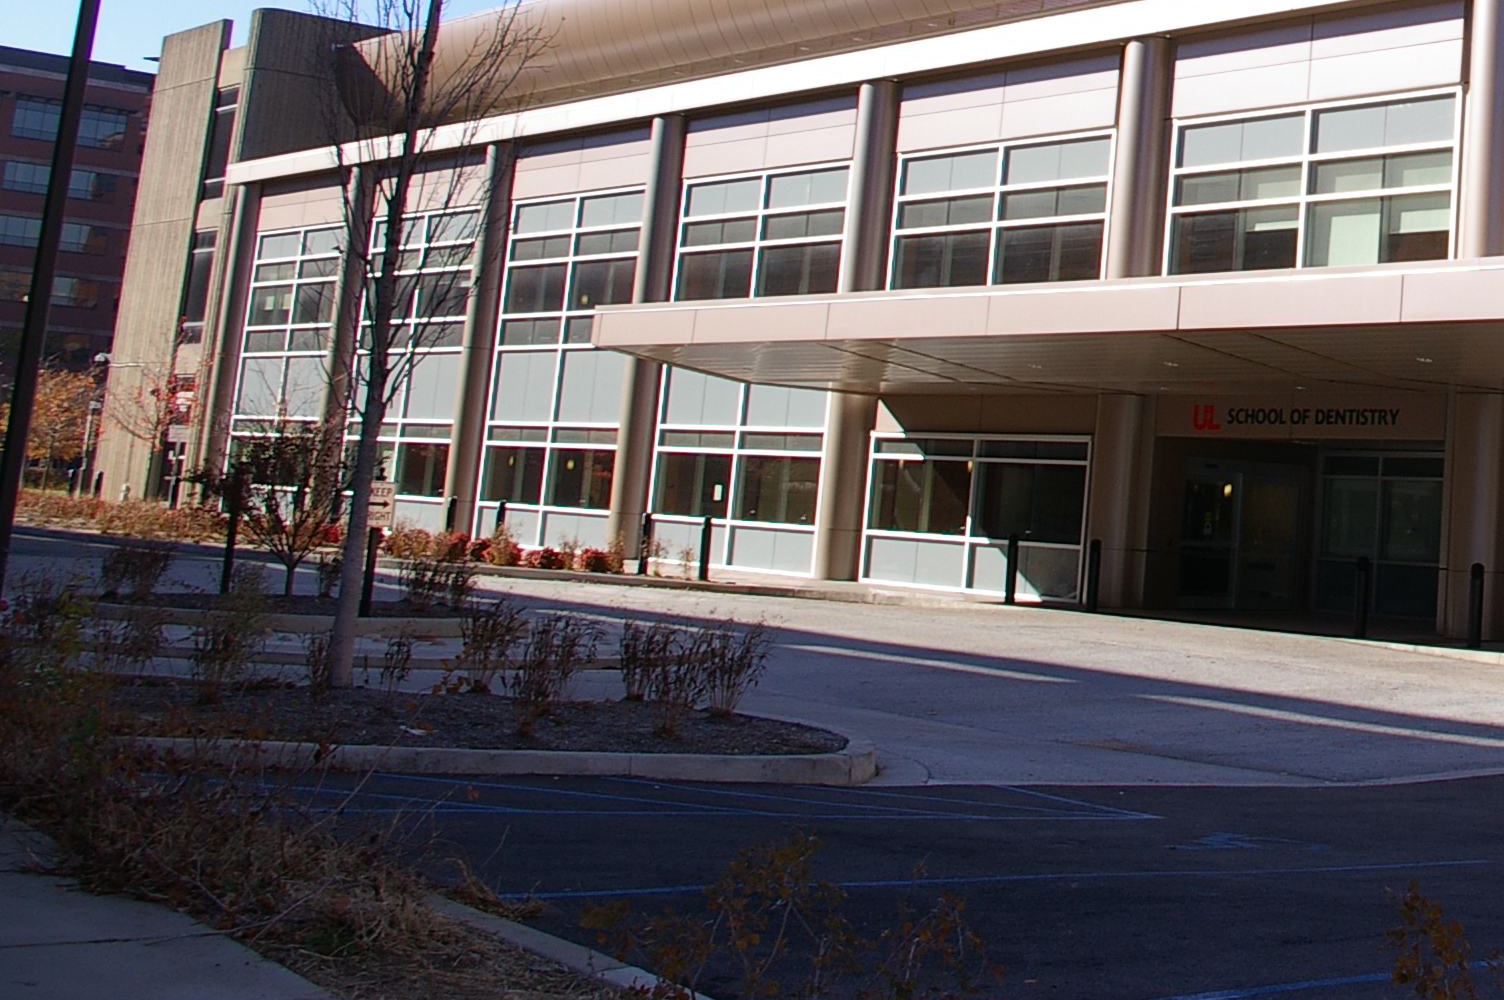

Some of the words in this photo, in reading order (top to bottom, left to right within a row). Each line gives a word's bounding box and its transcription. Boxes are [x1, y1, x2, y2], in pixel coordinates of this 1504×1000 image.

[1227, 408, 1286, 425] SCHOOL
[1290, 408, 1310, 425] OF
[1315, 408, 1400, 426] DENTISTRY
